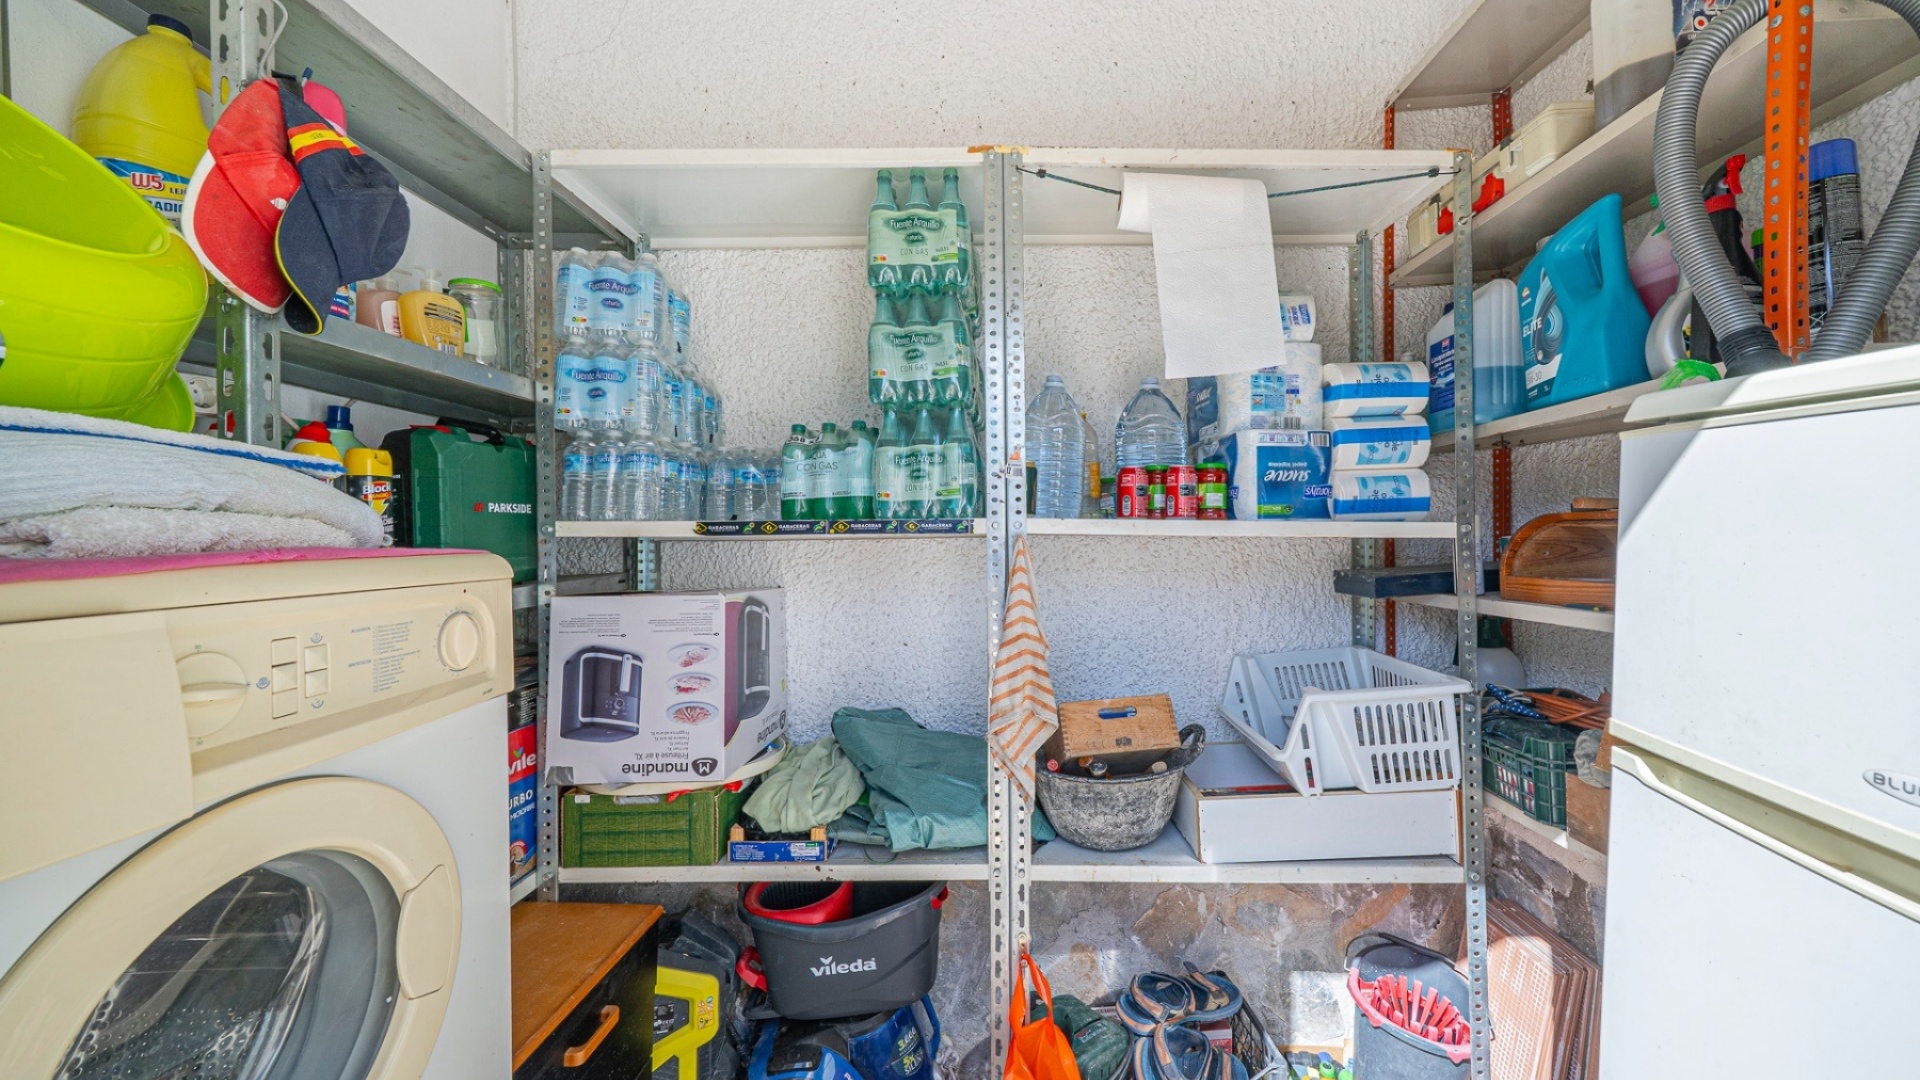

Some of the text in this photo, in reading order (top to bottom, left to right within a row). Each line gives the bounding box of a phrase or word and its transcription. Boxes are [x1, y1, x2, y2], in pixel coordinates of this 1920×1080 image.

[130, 171, 164, 191] W5
[1523, 317, 1542, 337] ELITE
[796, 461, 839, 472] CON GAS
[1264, 469, 1311, 482] suave
[488, 502, 532, 514] PARKSIDE
[508, 752, 537, 776] vile
[634, 753, 643, 761] XL
[621, 762, 689, 777] mandine
[1873, 772, 1920, 797] BLU
[508, 789, 534, 811] URBO
[810, 956, 877, 977] vileda
